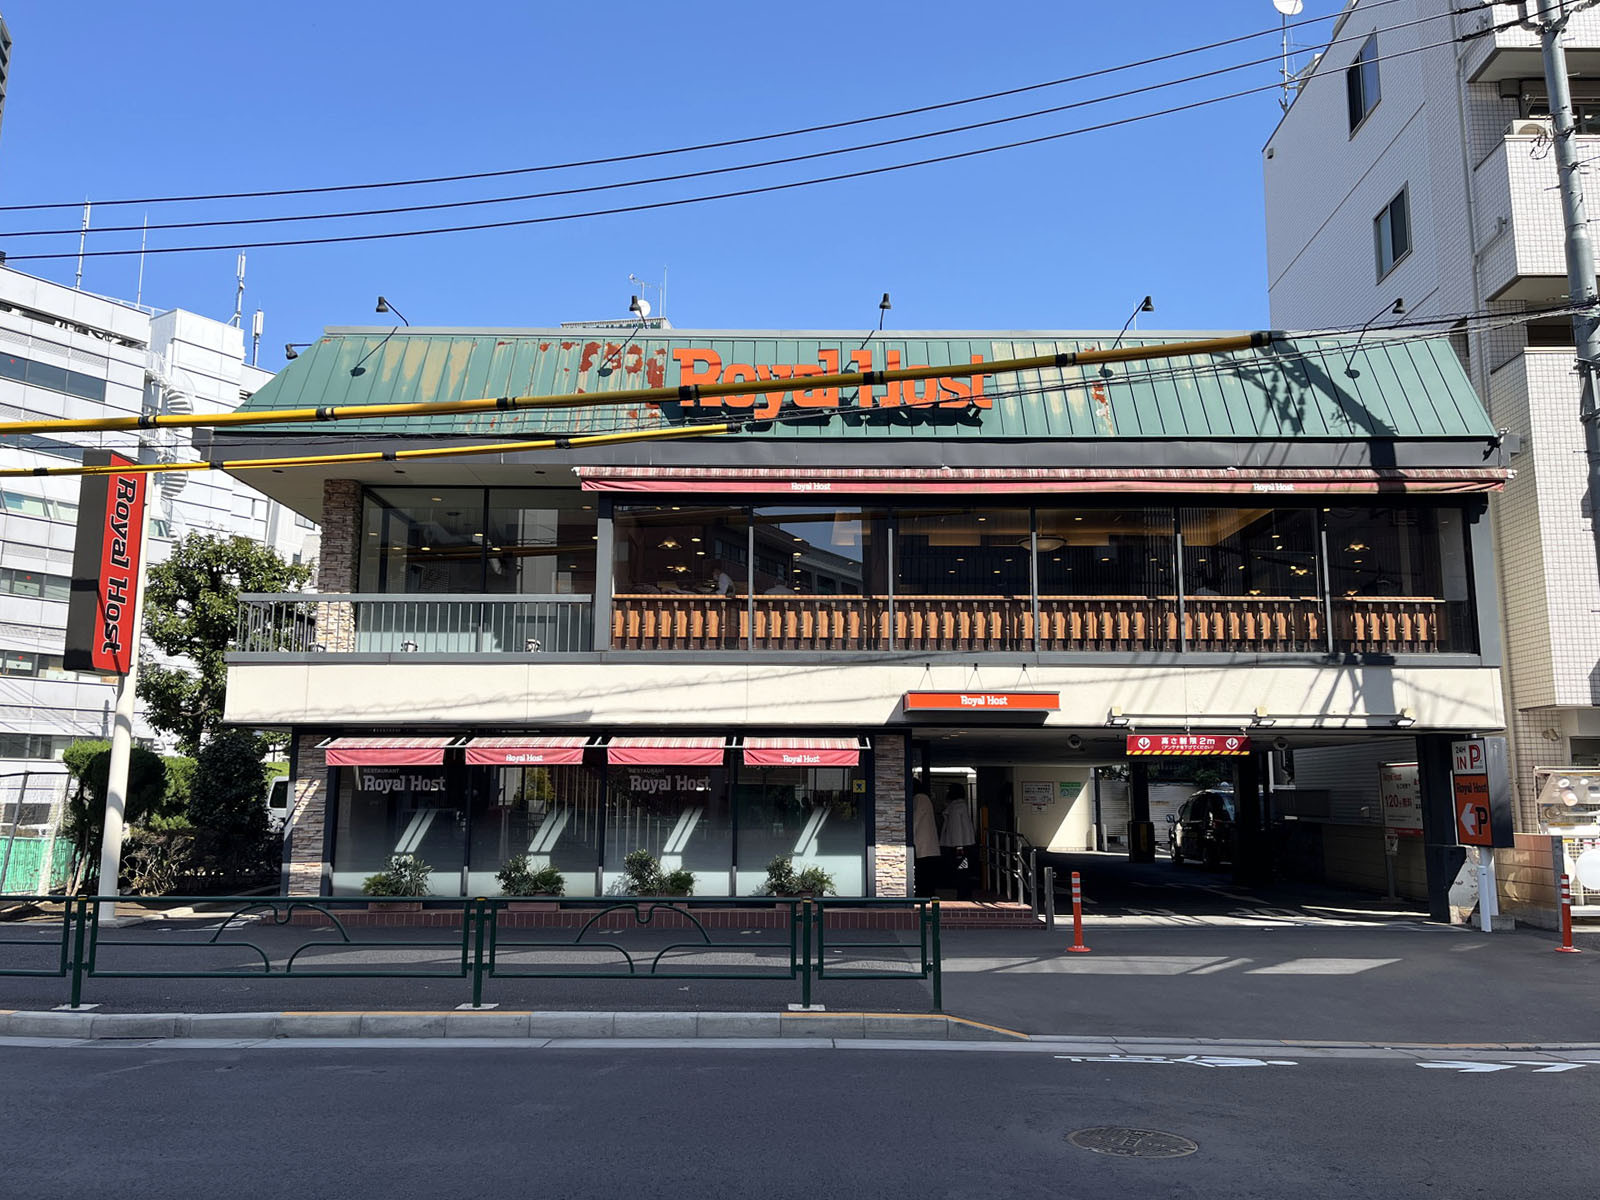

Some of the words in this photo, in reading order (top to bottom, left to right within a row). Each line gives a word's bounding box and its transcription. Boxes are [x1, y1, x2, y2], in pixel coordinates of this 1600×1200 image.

[673, 348, 839, 419] Royal
[851, 350, 993, 410] Host
[792, 482, 812, 492] Royal
[813, 482, 831, 490] Host
[1253, 482, 1274, 493] Royal
[110, 476, 137, 570] Royal
[102, 577, 128, 655] Host
[960, 695, 985, 706] Royal
[987, 696, 1008, 705] Host
[505, 753, 525, 763] Royal
[526, 754, 543, 762] Host
[782, 754, 803, 764] Royal
[803, 755, 820, 763] Host
[1456, 755, 1468, 769] IN
[1469, 744, 1481, 769] P
[363, 775, 405, 794] Royal
[409, 775, 446, 791] Host
[629, 775, 671, 794] Royal
[675, 775, 711, 792] Host
[1456, 782, 1472, 795] Royal
[1473, 782, 1488, 792] Host
[1475, 806, 1488, 835] P
